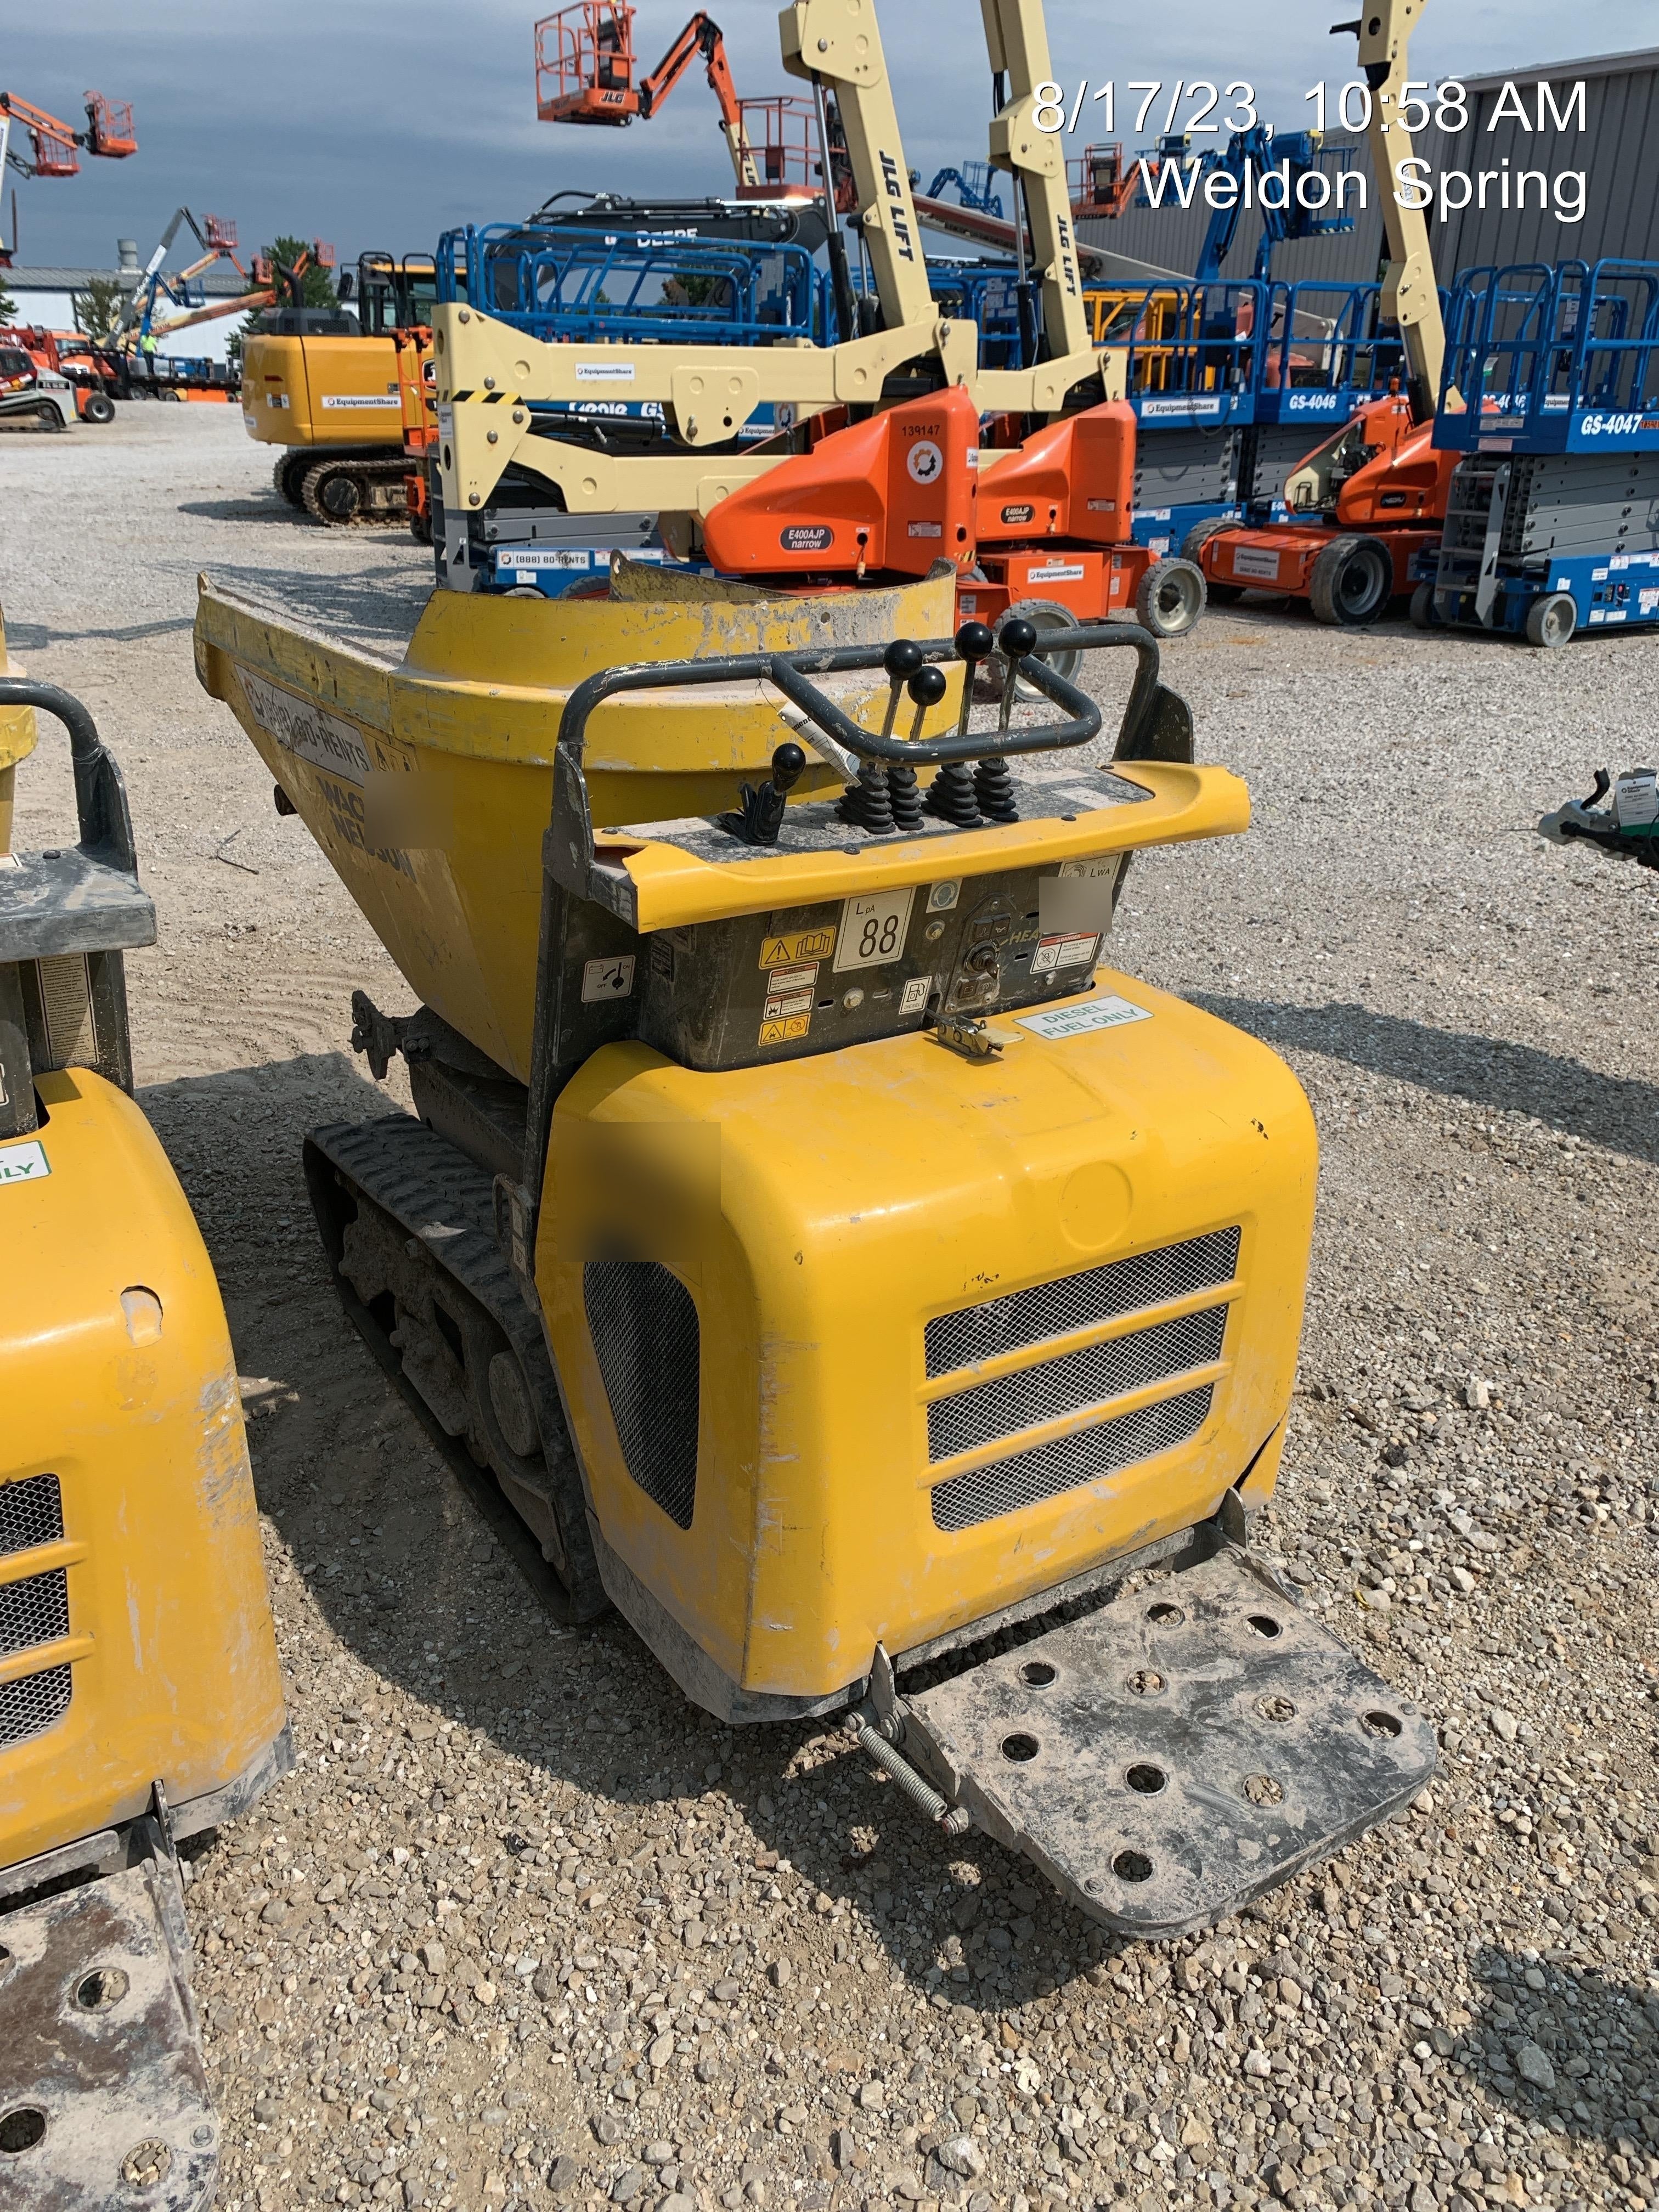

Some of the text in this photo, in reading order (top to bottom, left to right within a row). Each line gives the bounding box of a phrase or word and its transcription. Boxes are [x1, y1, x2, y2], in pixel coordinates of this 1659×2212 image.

[600, 91, 626, 106] JLG
[879, 149, 915, 262] JLG LIFT
[1057, 213, 1076, 296] JLG LIFT
[336, 398, 399, 407] EquipmentShare
[1289, 394, 1337, 410] GS-4046
[902, 425, 940, 437] 139147
[1581, 414, 1644, 436] GS-4047
[788, 529, 826, 540] E400AJP
[792, 540, 822, 549] narrow
[516, 554, 586, 564] (888) 80-RENTS
[1036, 569, 1082, 579] EquipmentShare
[859, 915, 899, 958] 88
[1060, 934, 1081, 943] DANGER
[1041, 1005, 1108, 1024] DIESEL
[1041, 1008, 1139, 1036] FUEL ONLY
[0, 1162, 35, 1179] LY
